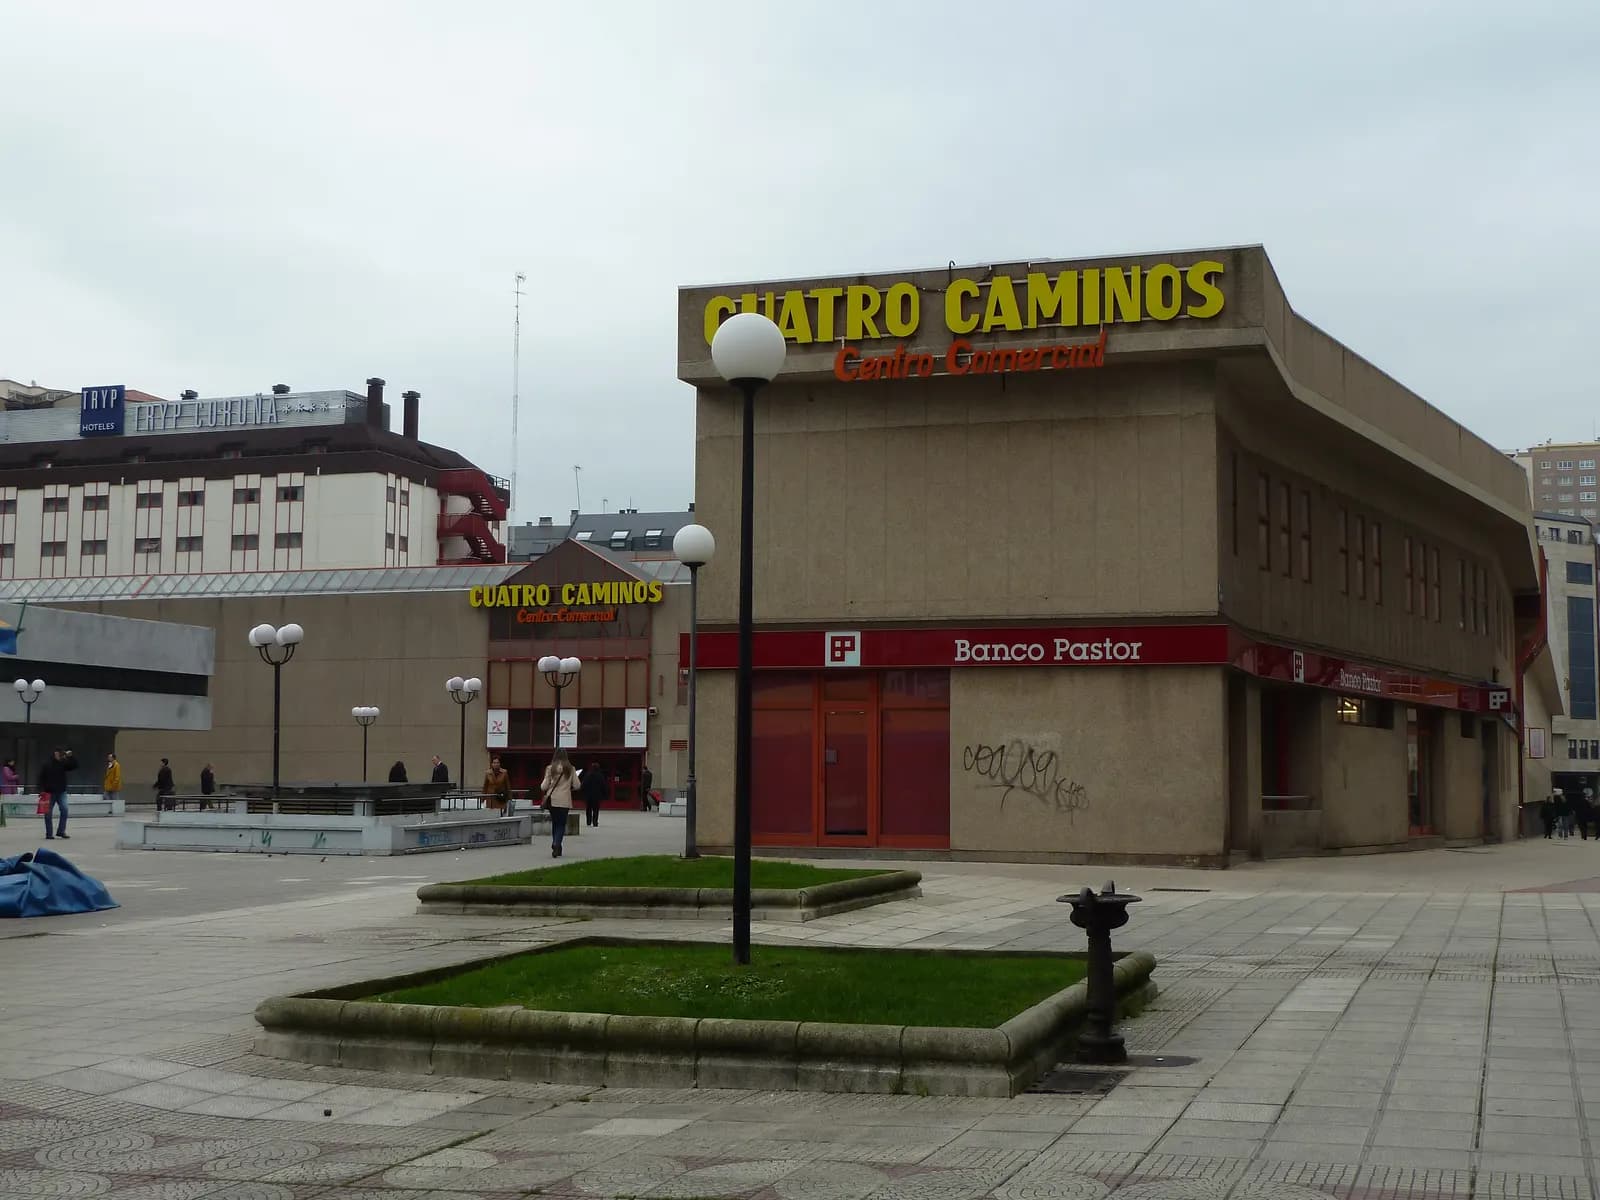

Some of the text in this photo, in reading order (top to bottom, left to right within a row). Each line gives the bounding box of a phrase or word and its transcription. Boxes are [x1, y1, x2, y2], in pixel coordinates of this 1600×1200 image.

[944, 260, 1225, 334] CAMINOS
[834, 329, 1108, 382] Centro Comercial
[83, 389, 118, 410] TRYP
[135, 393, 278, 432] TRYP CORUÑA
[82, 422, 115, 432] HOTELES
[469, 580, 663, 608] CUATRO CAMINOS
[516, 606, 617, 624] Centro Comercial
[954, 637, 1143, 661] Banco Pastor
[1339, 668, 1361, 689] Banco
